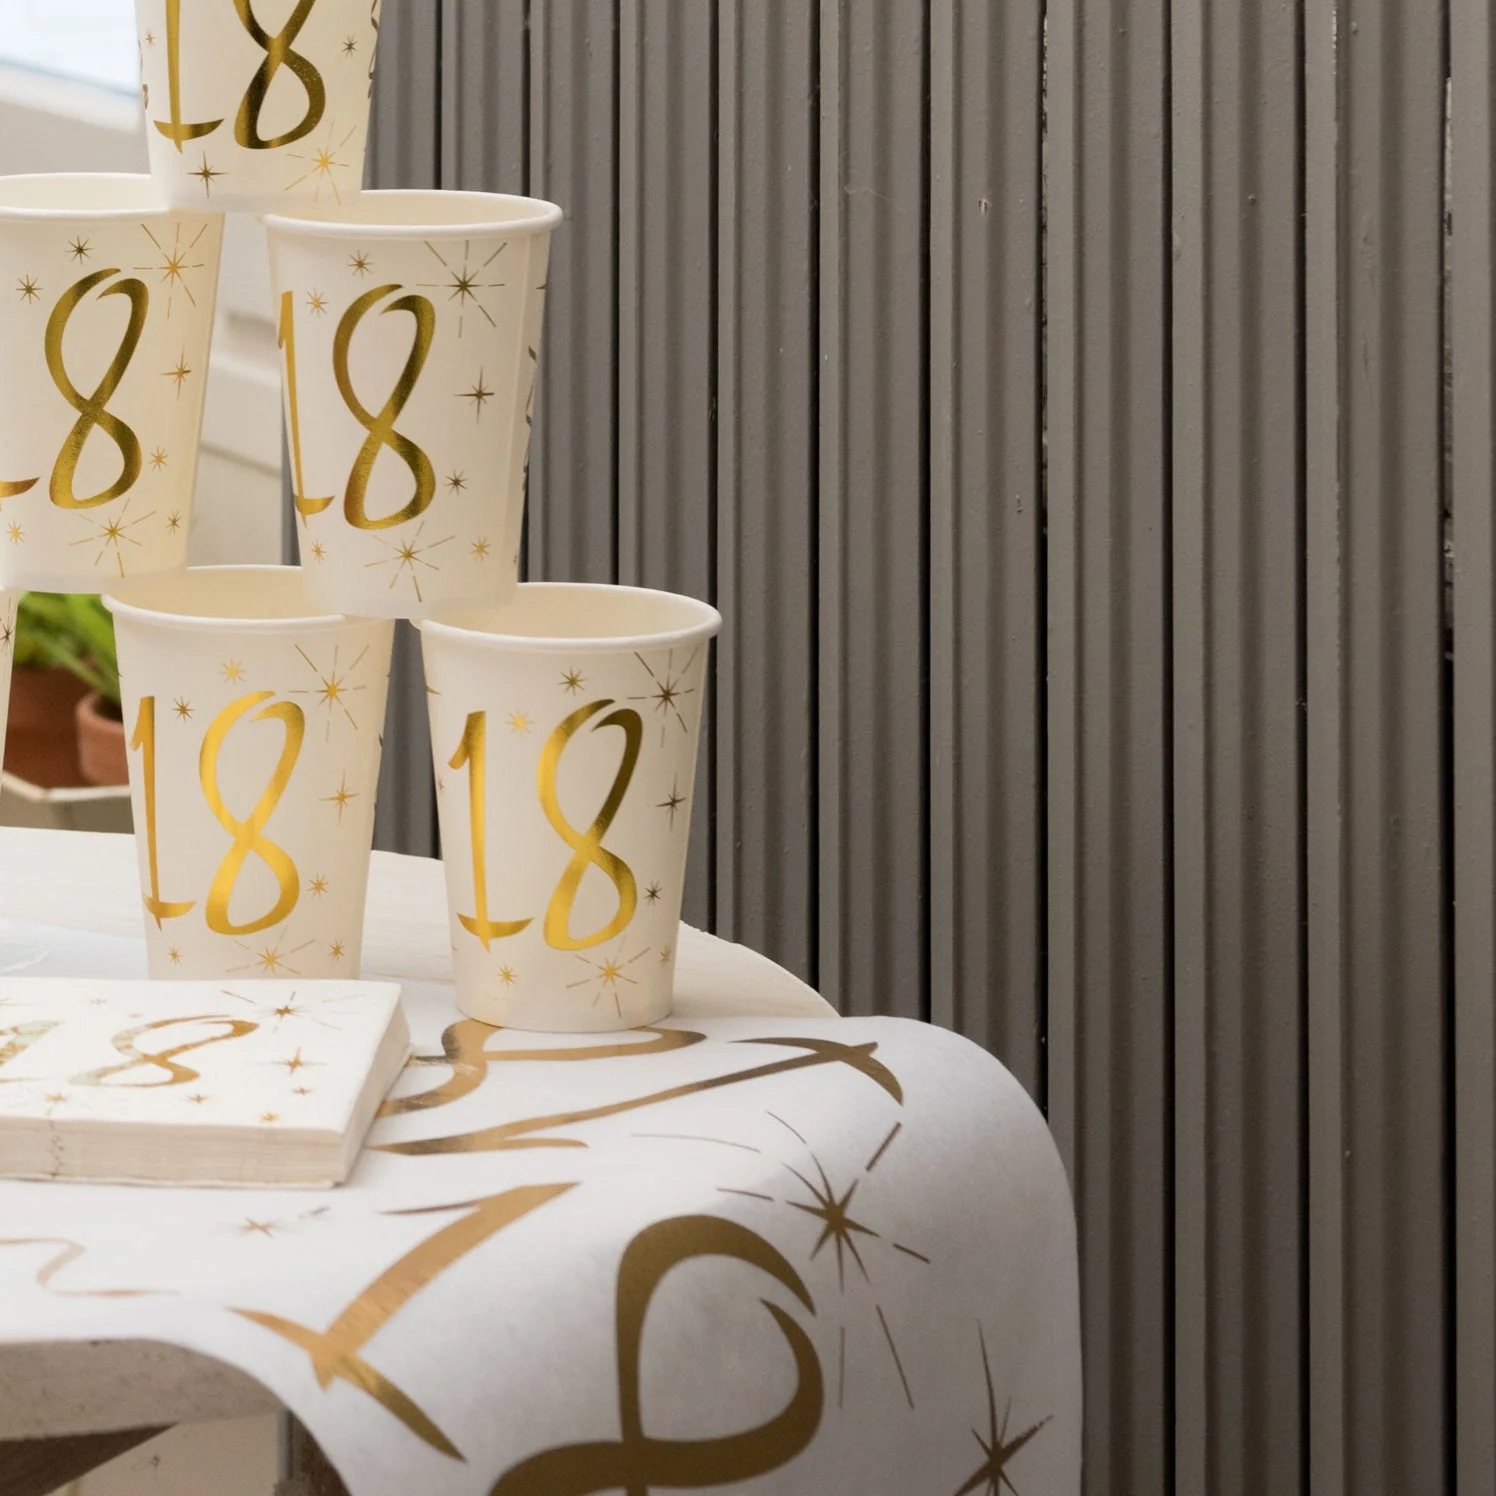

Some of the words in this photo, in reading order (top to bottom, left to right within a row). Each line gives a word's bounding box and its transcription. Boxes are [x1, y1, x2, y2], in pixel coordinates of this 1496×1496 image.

[275, 283, 436, 531] 18
[130, 690, 307, 936] 18
[446, 698, 645, 952] 18
